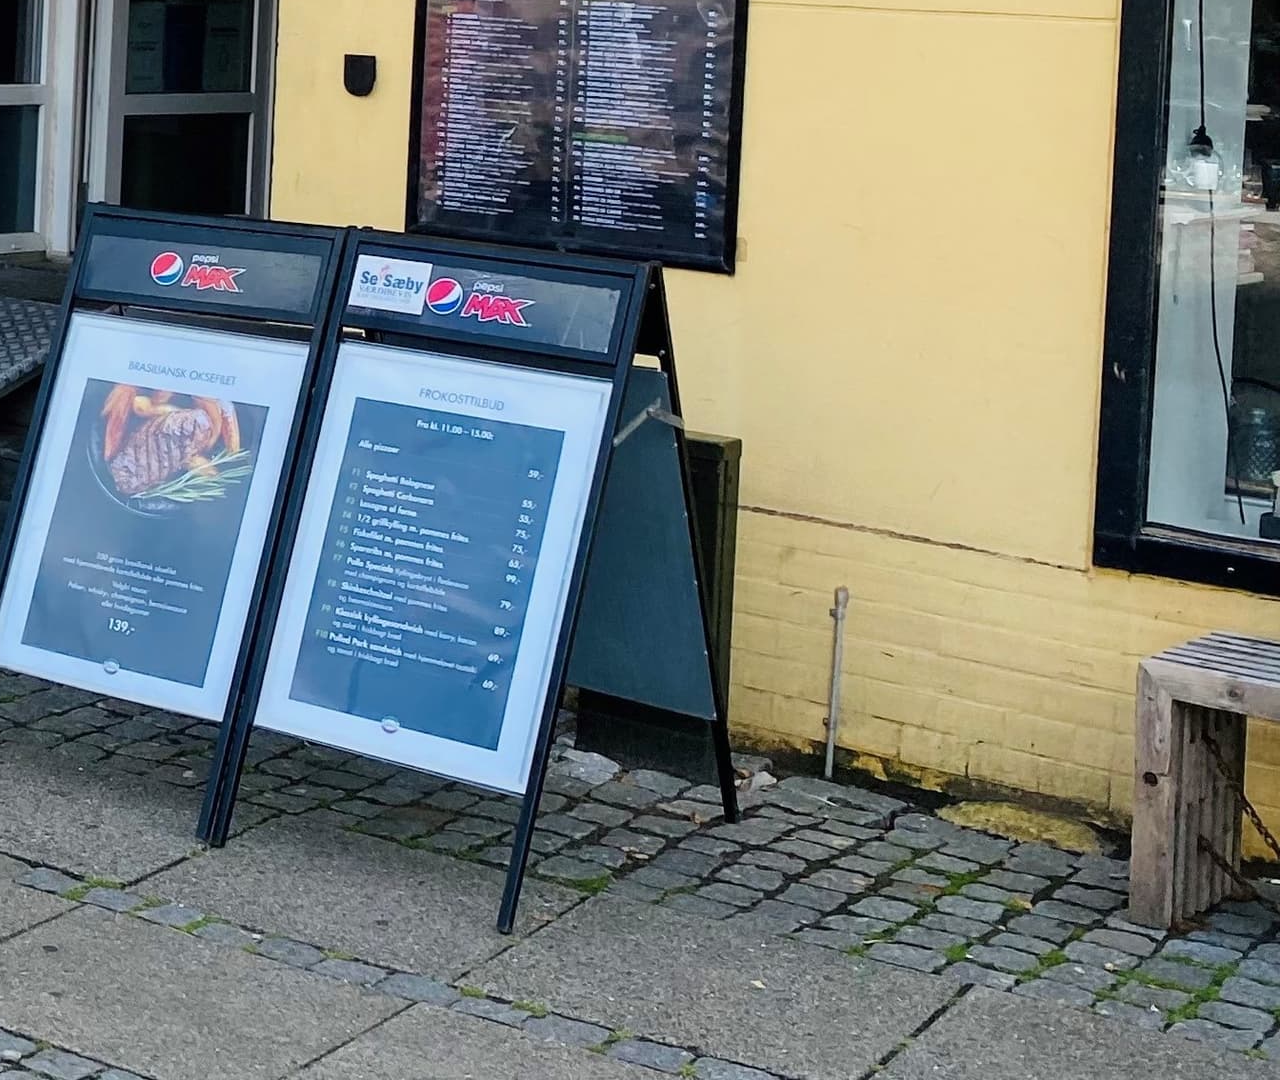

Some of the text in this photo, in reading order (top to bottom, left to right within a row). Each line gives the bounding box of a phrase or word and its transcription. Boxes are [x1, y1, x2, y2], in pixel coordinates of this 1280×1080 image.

[191, 253, 219, 264] pepsi
[182, 263, 246, 293] MAX
[360, 271, 424, 294] Se Sæby
[473, 280, 503, 294] pepsi
[460, 294, 536, 326] MAX
[128, 360, 236, 386] BRASILIANSK OKSEFILET
[419, 388, 505, 411] FROKOSTTILBUD
[357, 513, 371, 523] 1/2
[108, 617, 136, 636] 139,-
